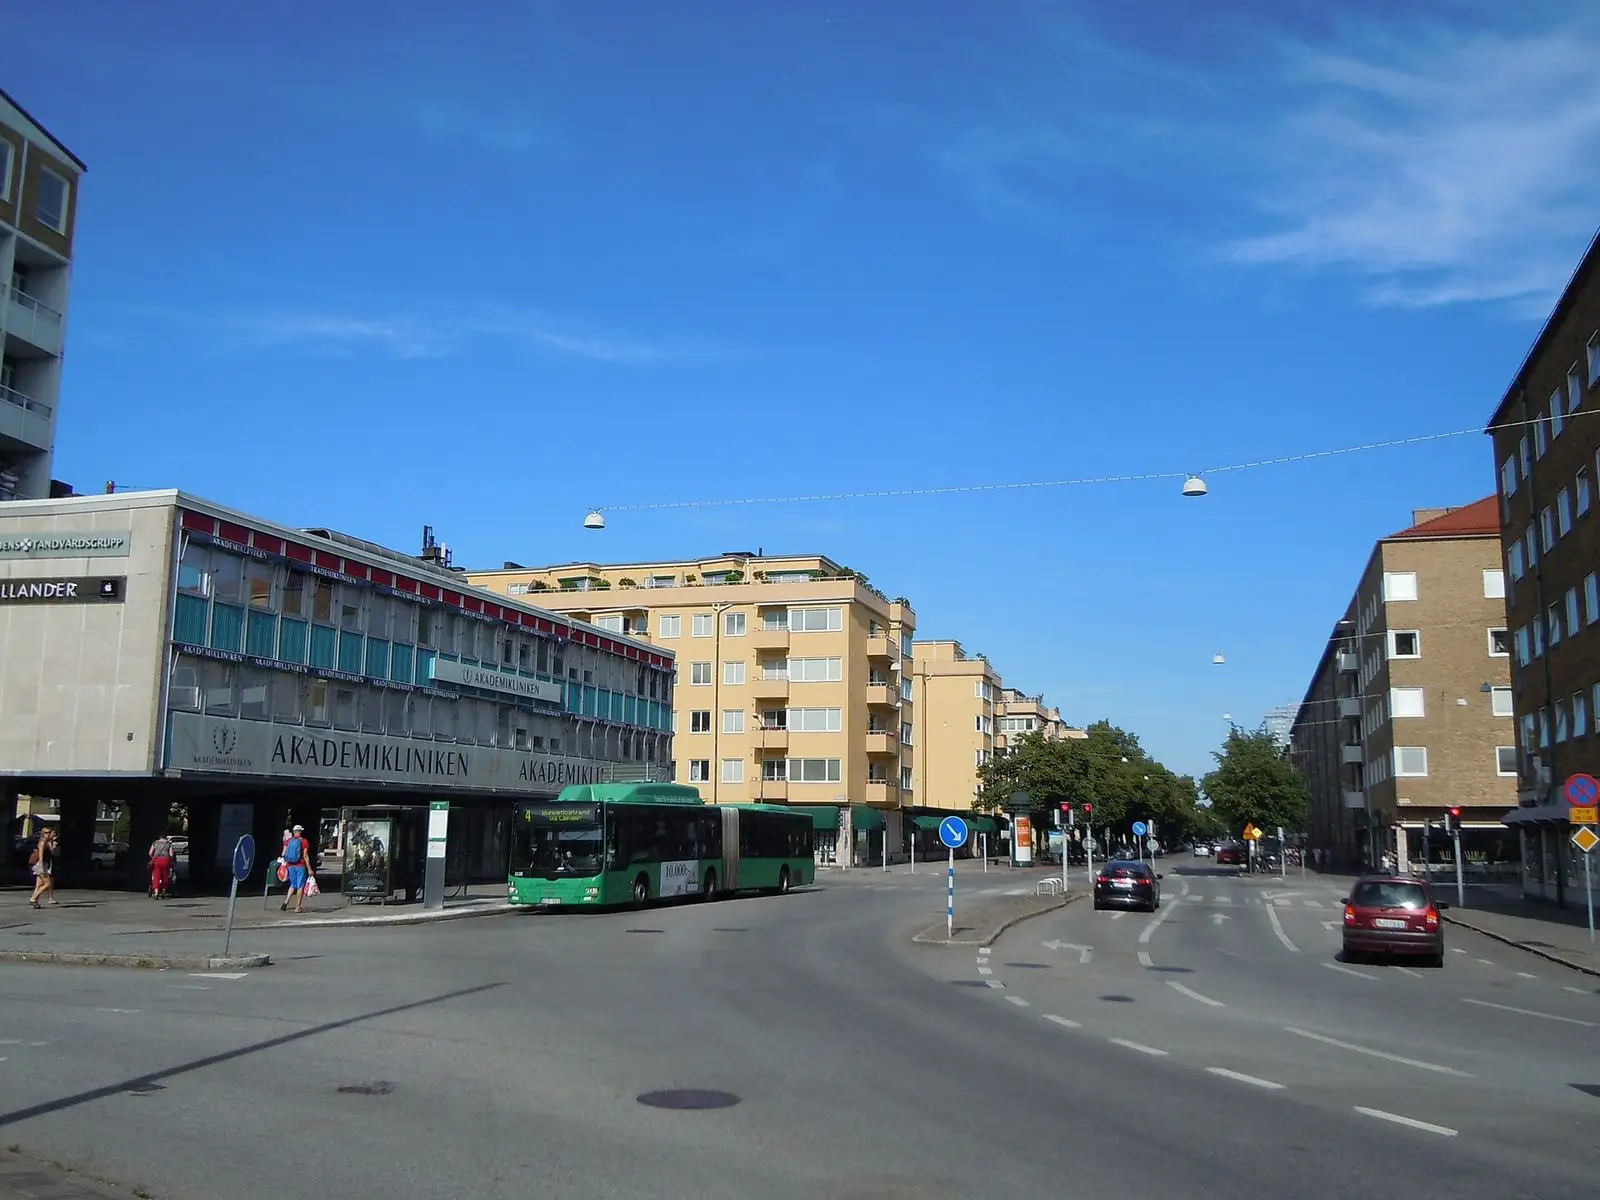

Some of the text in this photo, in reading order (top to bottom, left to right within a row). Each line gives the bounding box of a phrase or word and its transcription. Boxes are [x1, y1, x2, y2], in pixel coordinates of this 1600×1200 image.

[1, 582, 77, 598] LLANDER
[183, 645, 243, 662] AKADEMIKLINIKEN
[255, 658, 308, 673] AKADEMIKLINIKEN
[474, 672, 540, 695] AKADEMIKLINIKEN
[192, 754, 253, 766] AKADEMIKLINIKEN
[272, 734, 469, 776] AKADEMIKLINIKEN
[525, 810, 531, 822] 4
